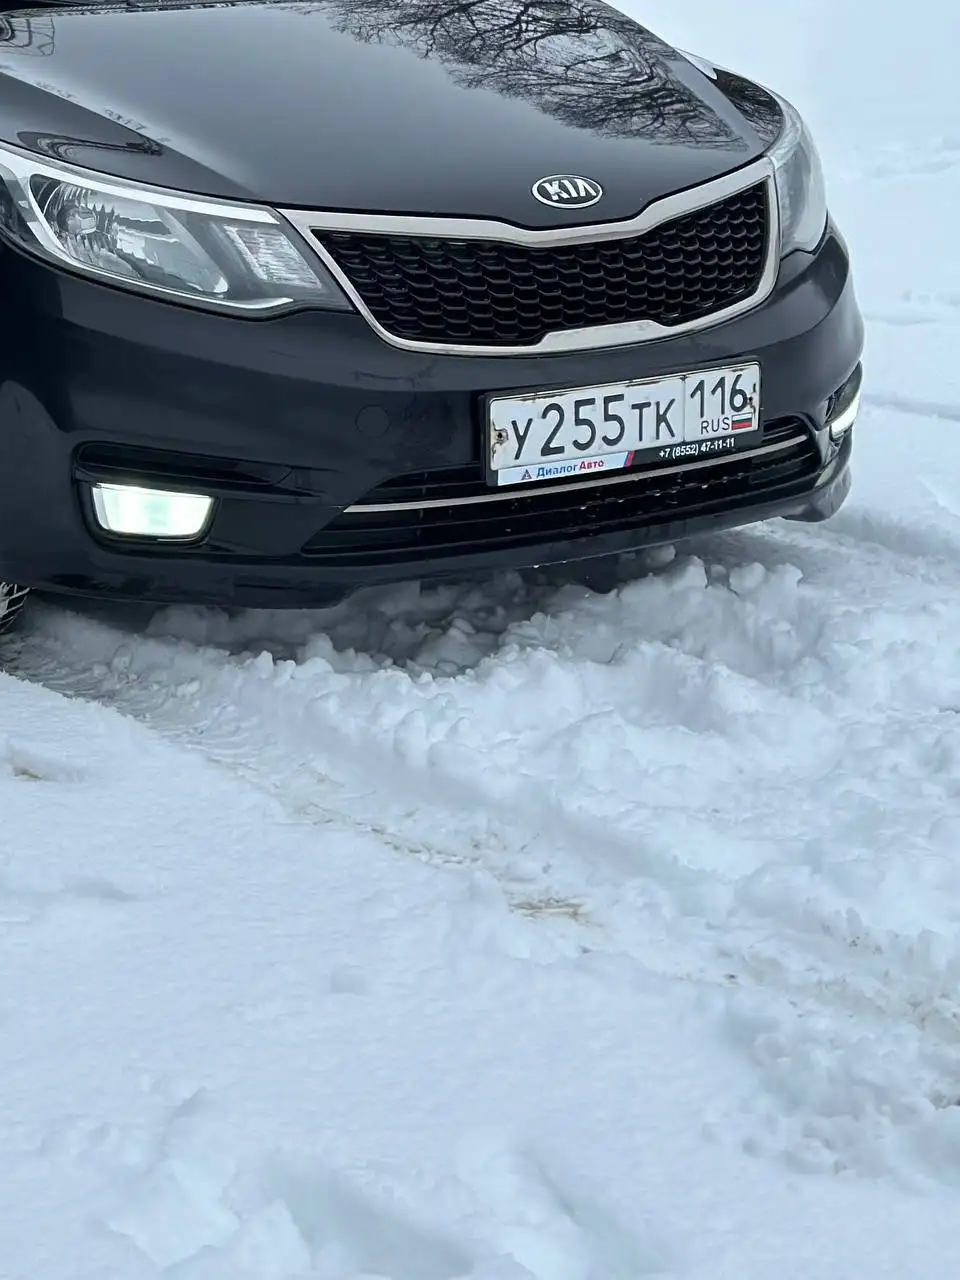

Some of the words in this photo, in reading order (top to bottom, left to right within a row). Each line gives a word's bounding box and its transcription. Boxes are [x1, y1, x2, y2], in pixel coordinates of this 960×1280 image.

[542, 179, 597, 201] KIA
[690, 374, 748, 418] 116
[700, 416, 730, 435] RUS
[659, 448, 671, 459] +7
[672, 443, 699, 459] (8552)
[700, 437, 735, 452] 47-11-11
